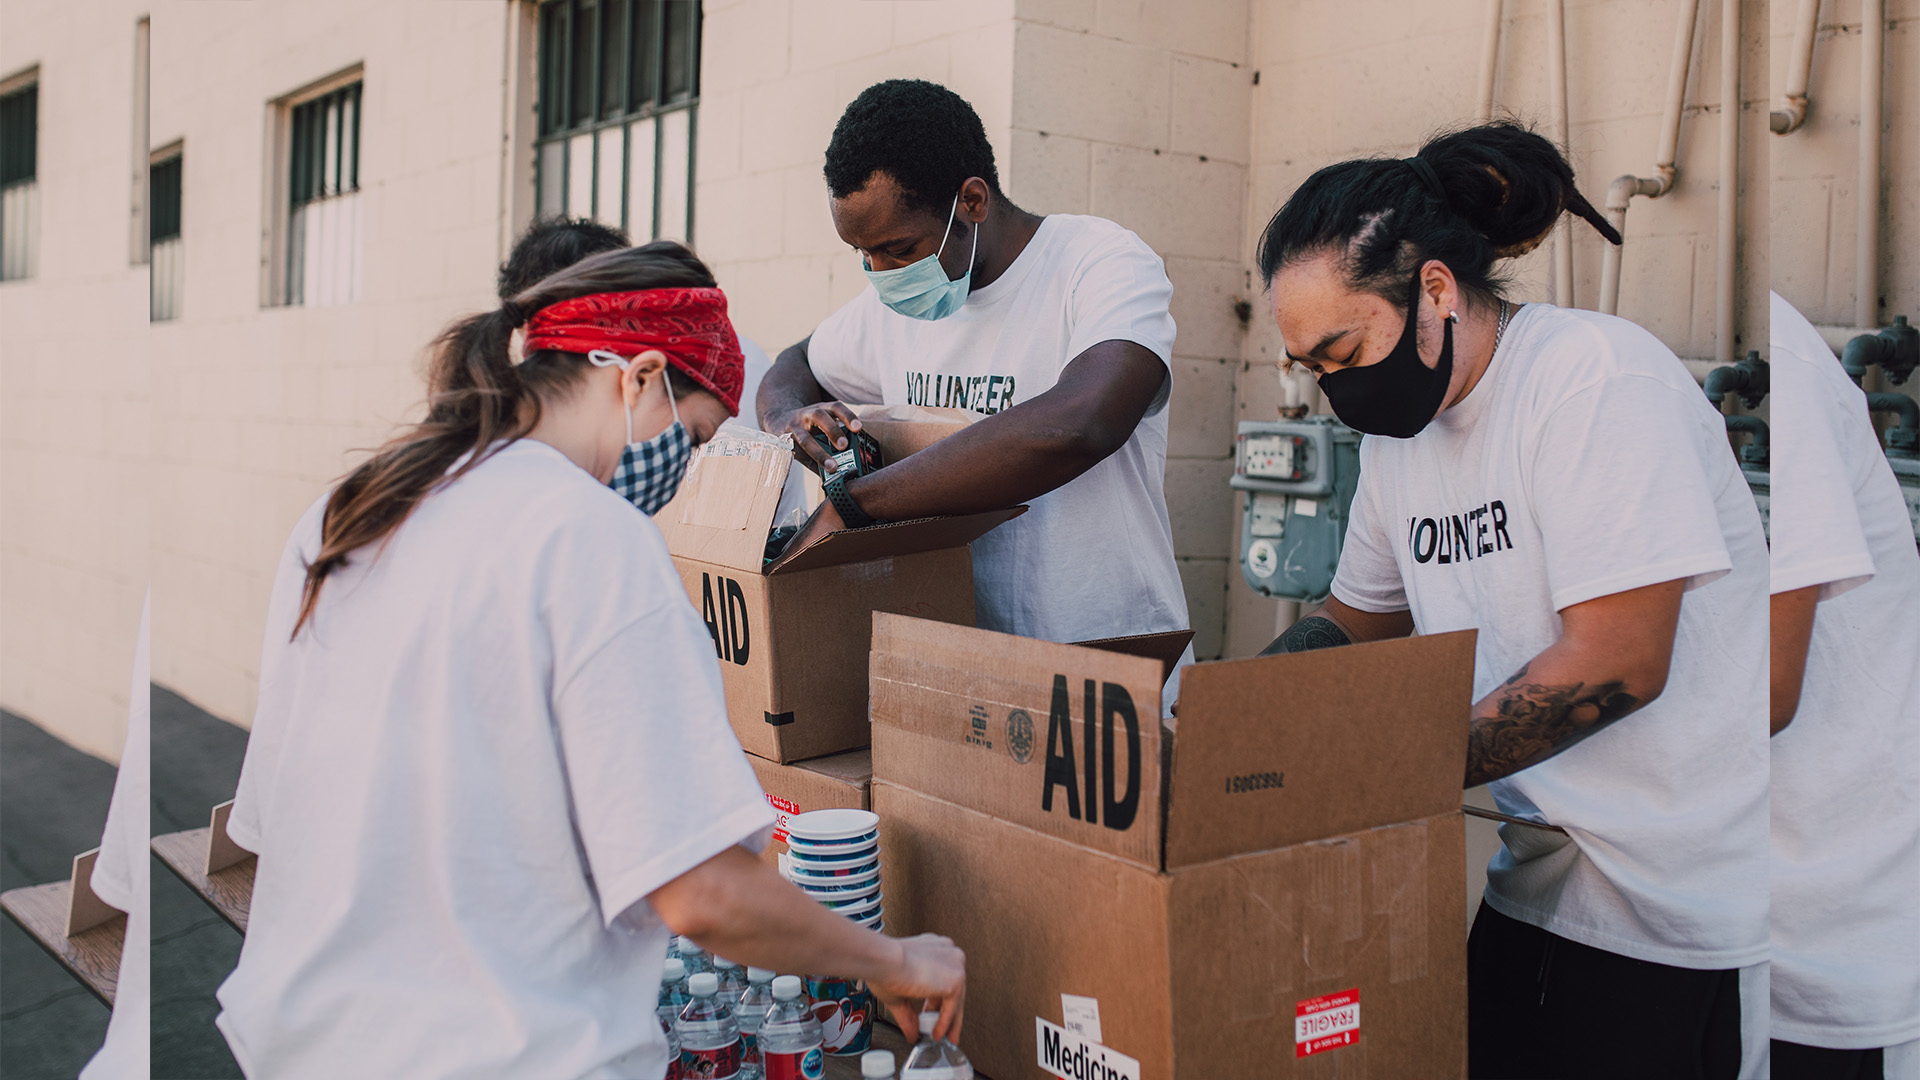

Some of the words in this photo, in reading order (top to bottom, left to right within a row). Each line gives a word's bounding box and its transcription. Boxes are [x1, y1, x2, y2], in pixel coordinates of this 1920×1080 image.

[702, 571, 750, 666] AID
[1042, 673, 1142, 832] AID
[1043, 1025, 1129, 1080] Medici
[1301, 1008, 1354, 1037] FRAGILE
